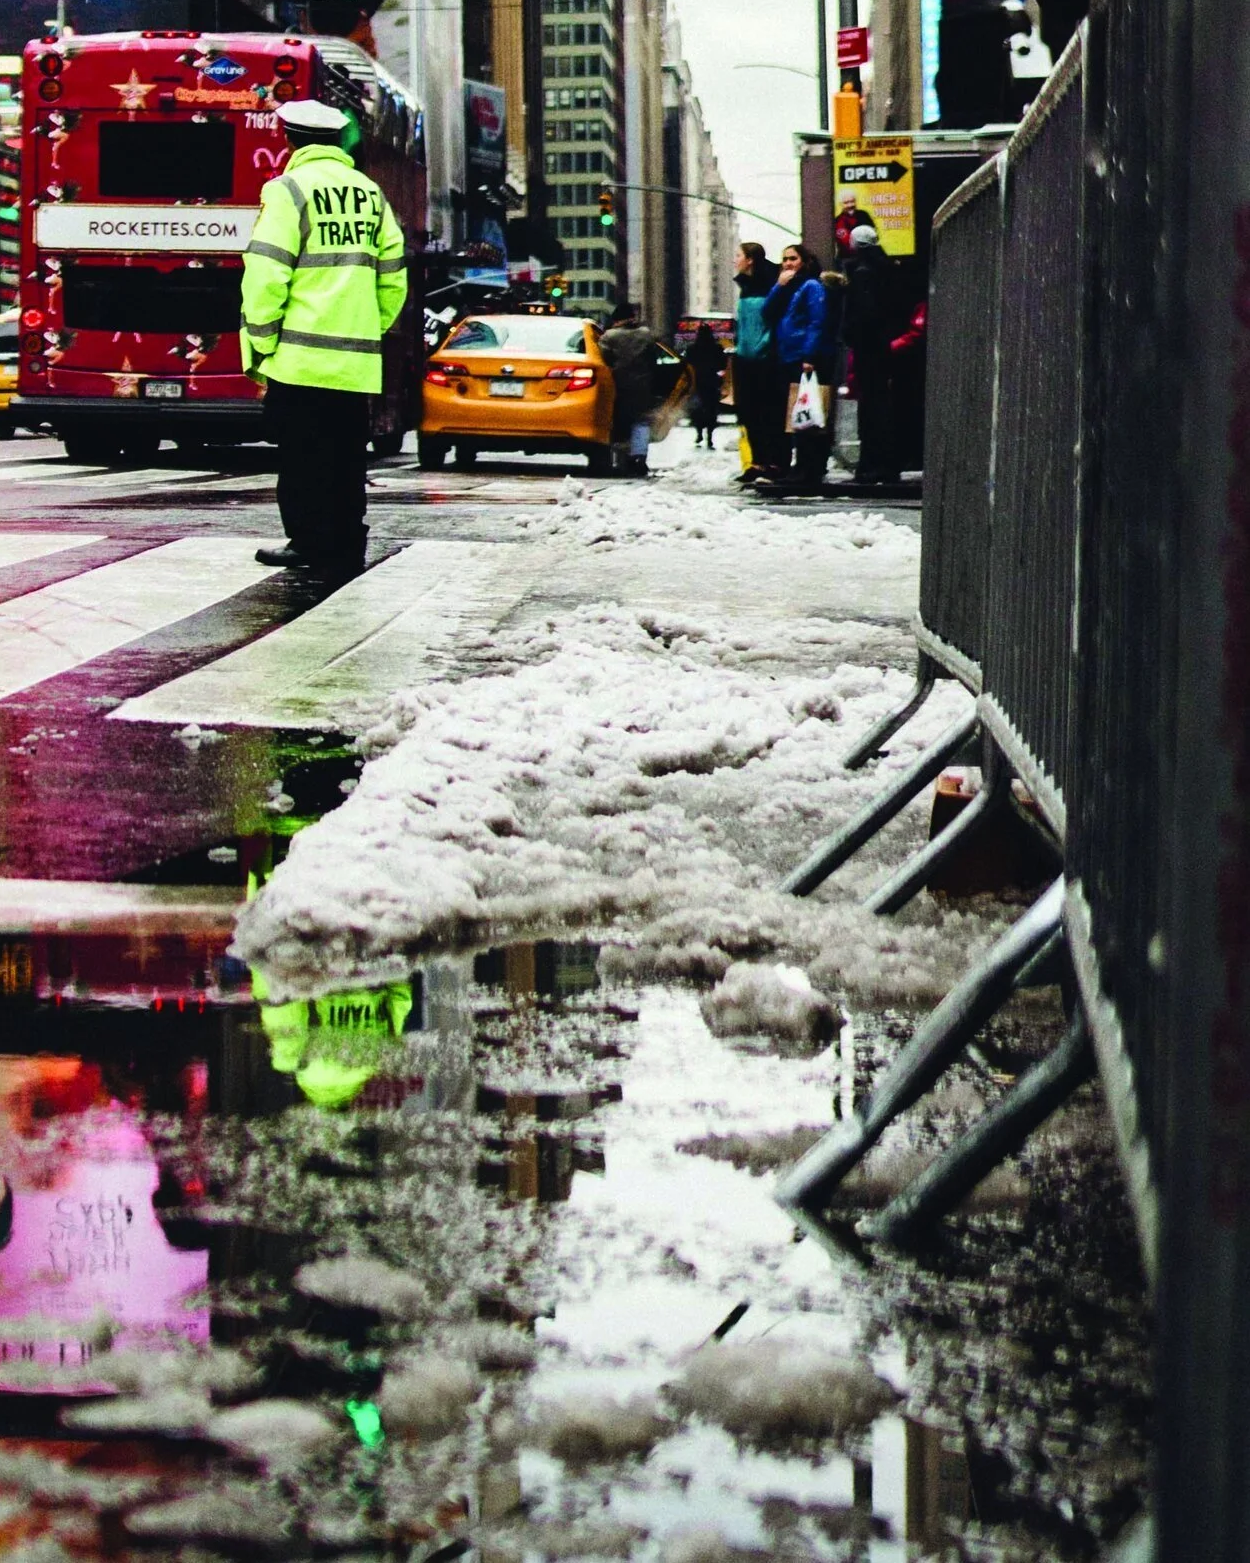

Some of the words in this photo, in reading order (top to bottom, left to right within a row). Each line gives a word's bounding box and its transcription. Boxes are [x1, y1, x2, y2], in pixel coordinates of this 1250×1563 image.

[245, 112, 279, 130] 71612
[844, 166, 888, 181] OPEN
[88, 221, 238, 238] ROCKETTES.COM
